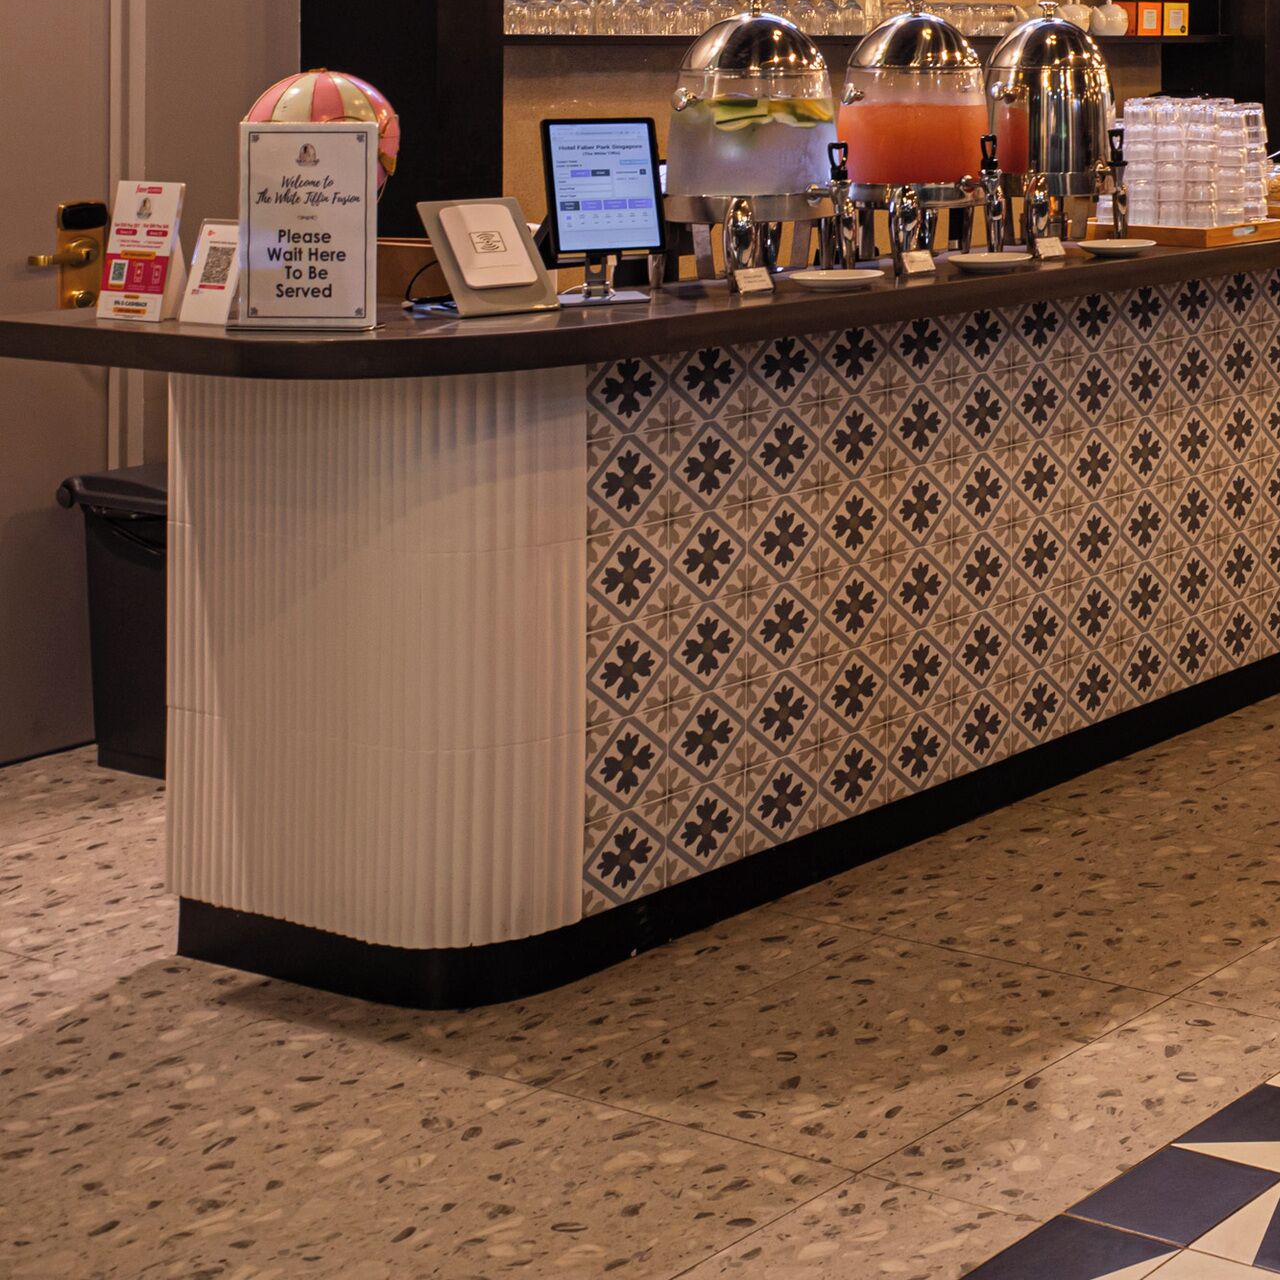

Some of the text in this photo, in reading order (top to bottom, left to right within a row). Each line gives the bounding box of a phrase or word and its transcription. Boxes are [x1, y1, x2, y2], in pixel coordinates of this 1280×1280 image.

[281, 175, 334, 188] Welcome to
[255, 188, 361, 207] The White Tiffin Fusion
[278, 229, 332, 244] Please
[267, 247, 347, 262] Wait Here
[284, 266, 329, 280] To Be
[275, 283, 333, 299] Served
